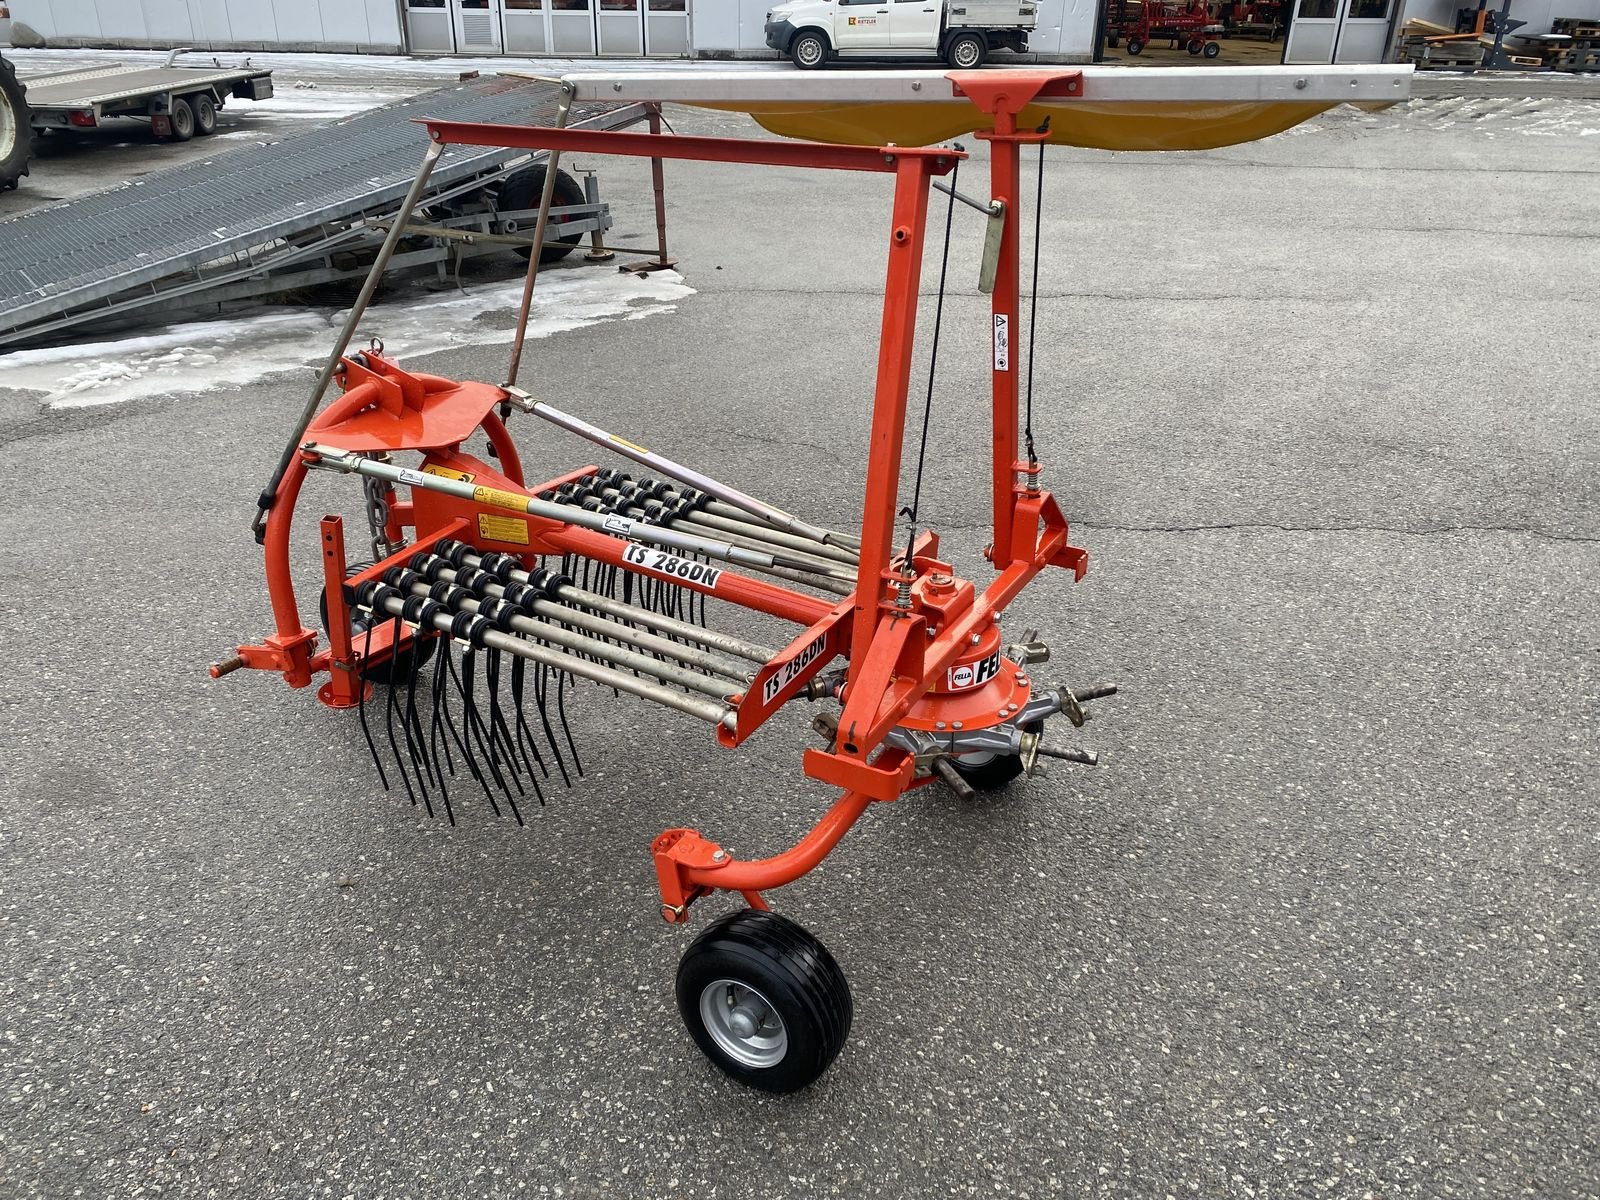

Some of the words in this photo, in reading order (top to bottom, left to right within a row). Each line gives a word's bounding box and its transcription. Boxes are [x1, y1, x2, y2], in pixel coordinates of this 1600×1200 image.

[627, 545, 649, 564] TS
[652, 554, 719, 586] 286DN
[765, 672, 780, 701] TS
[785, 635, 825, 684] 286DN
[954, 672, 972, 681] FELLA
